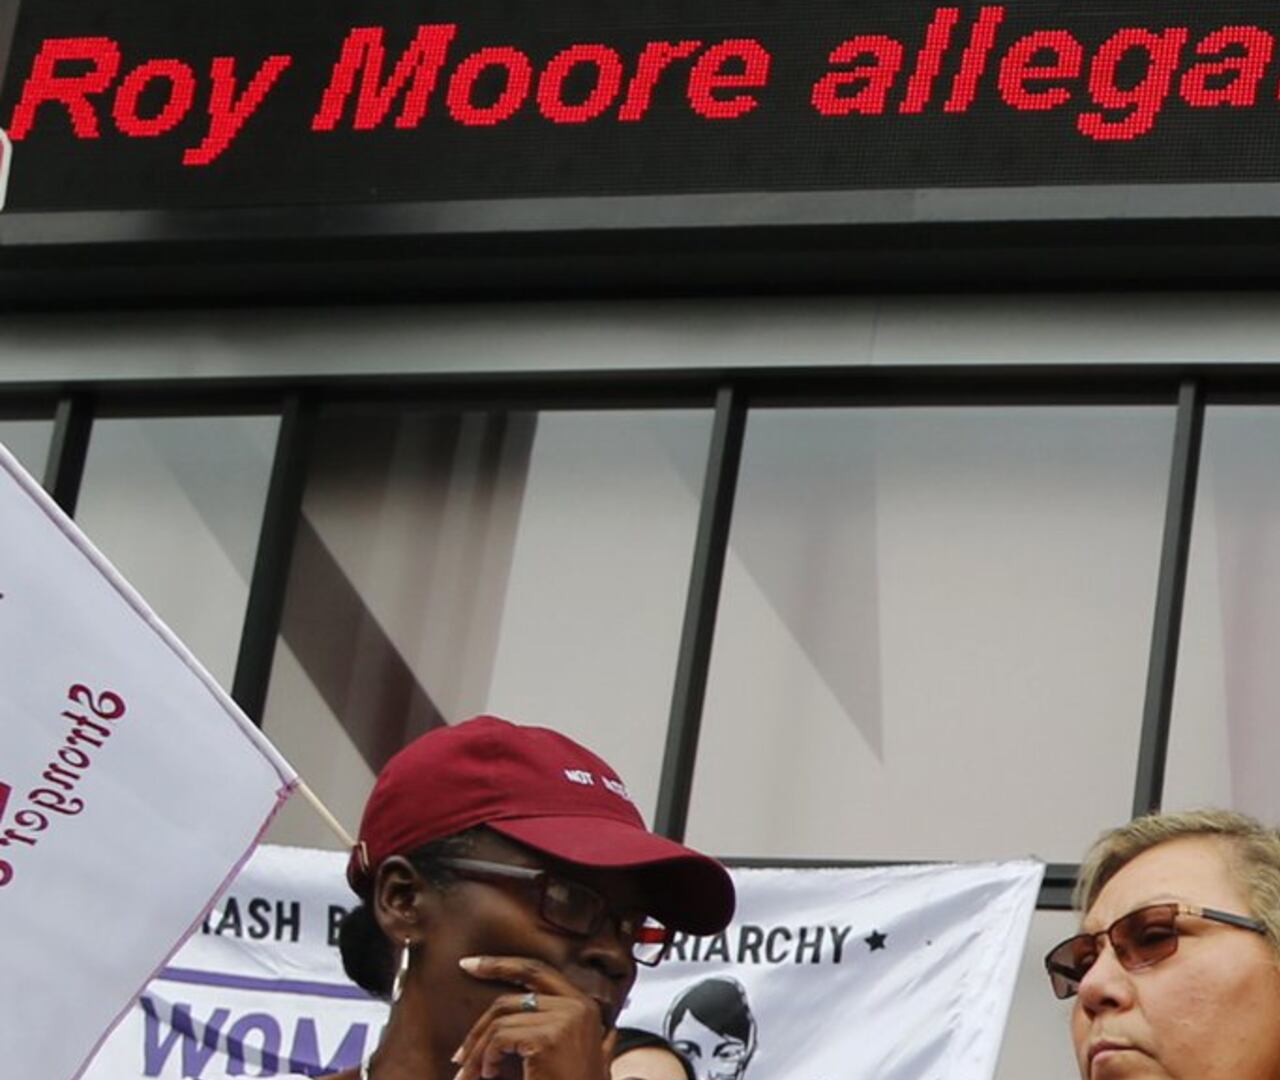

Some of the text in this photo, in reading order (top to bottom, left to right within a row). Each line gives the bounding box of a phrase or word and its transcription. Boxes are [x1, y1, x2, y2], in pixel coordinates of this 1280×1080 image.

[9, 36, 292, 166] Roy
[311, 23, 772, 132] Moore
[202, 896, 301, 944] ASH
[664, 924, 852, 965] RIARCHY
[140, 995, 369, 1078] WOM
